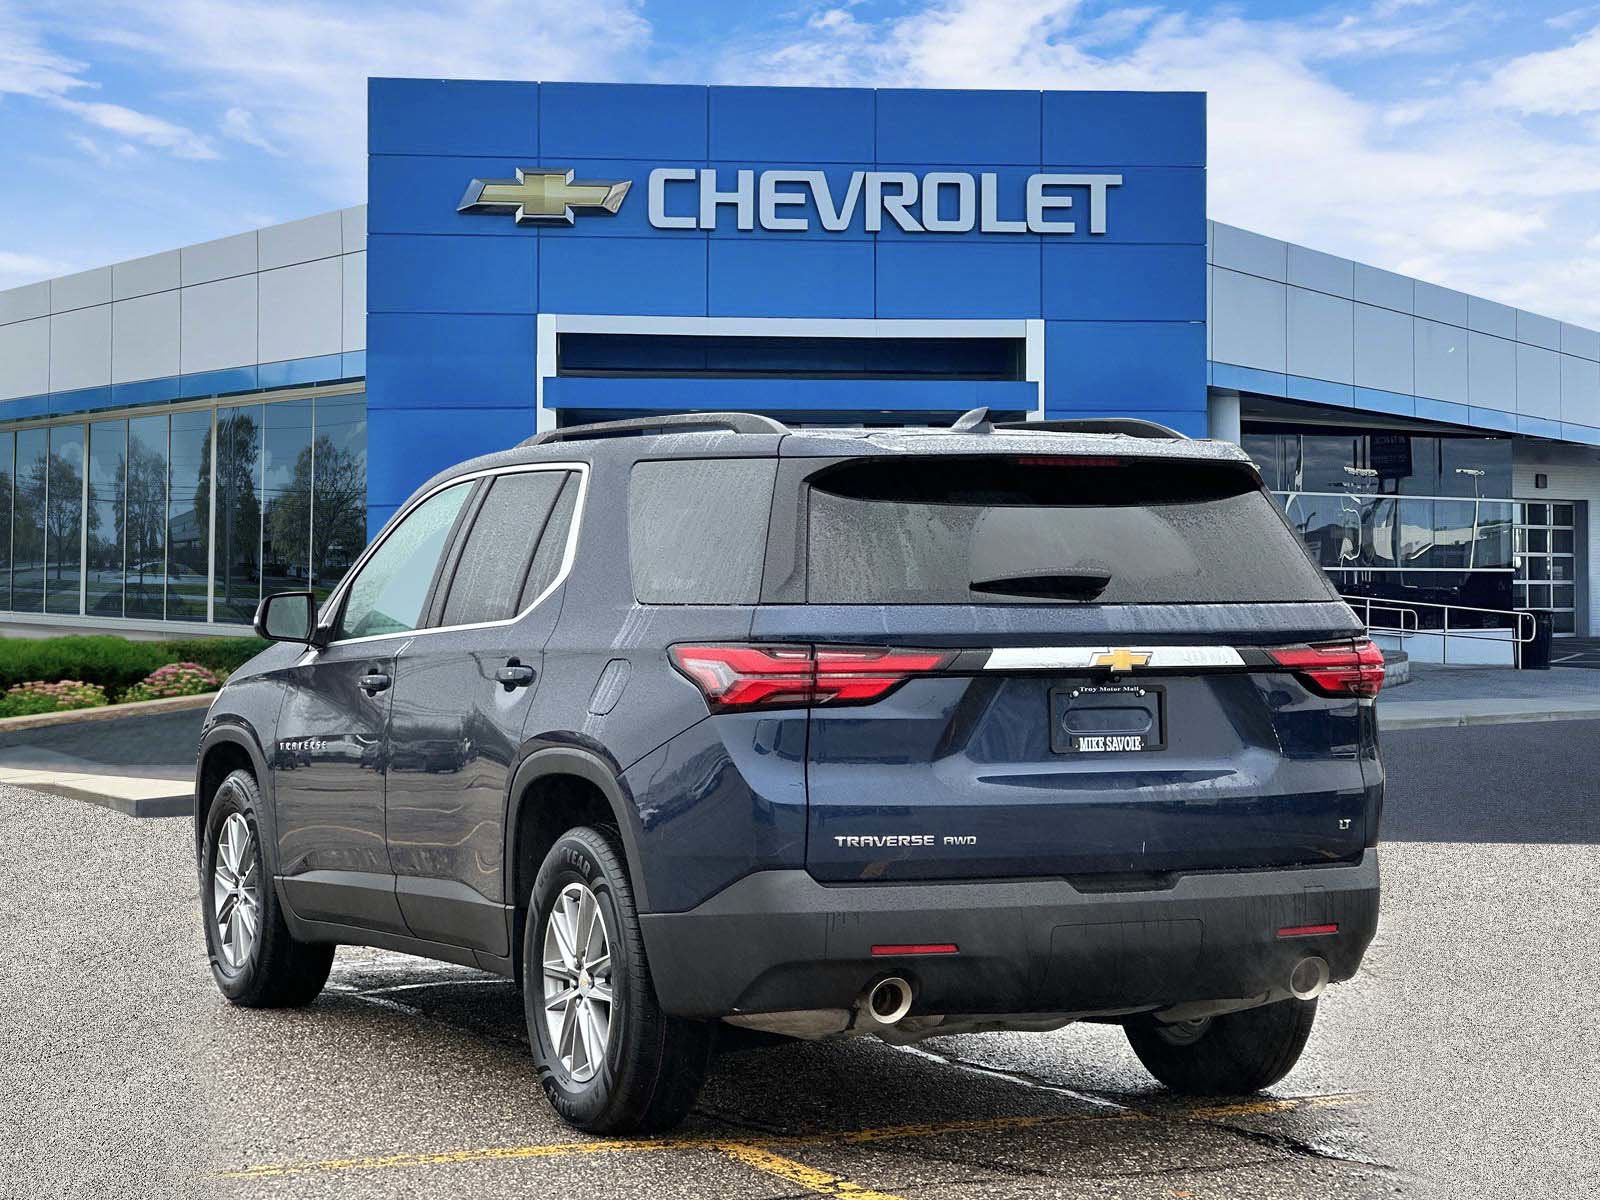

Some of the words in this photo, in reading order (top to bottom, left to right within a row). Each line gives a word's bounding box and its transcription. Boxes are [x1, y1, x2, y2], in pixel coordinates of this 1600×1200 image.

[648, 167, 1123, 234] CHEVROLET
[279, 740, 328, 751] TRAVERSE
[1079, 736, 1105, 752] MIKE
[1106, 736, 1141, 752] SAVOIE
[1338, 818, 1352, 830] LT
[834, 835, 935, 847] TRAVERSE
[943, 835, 977, 845] AWD
